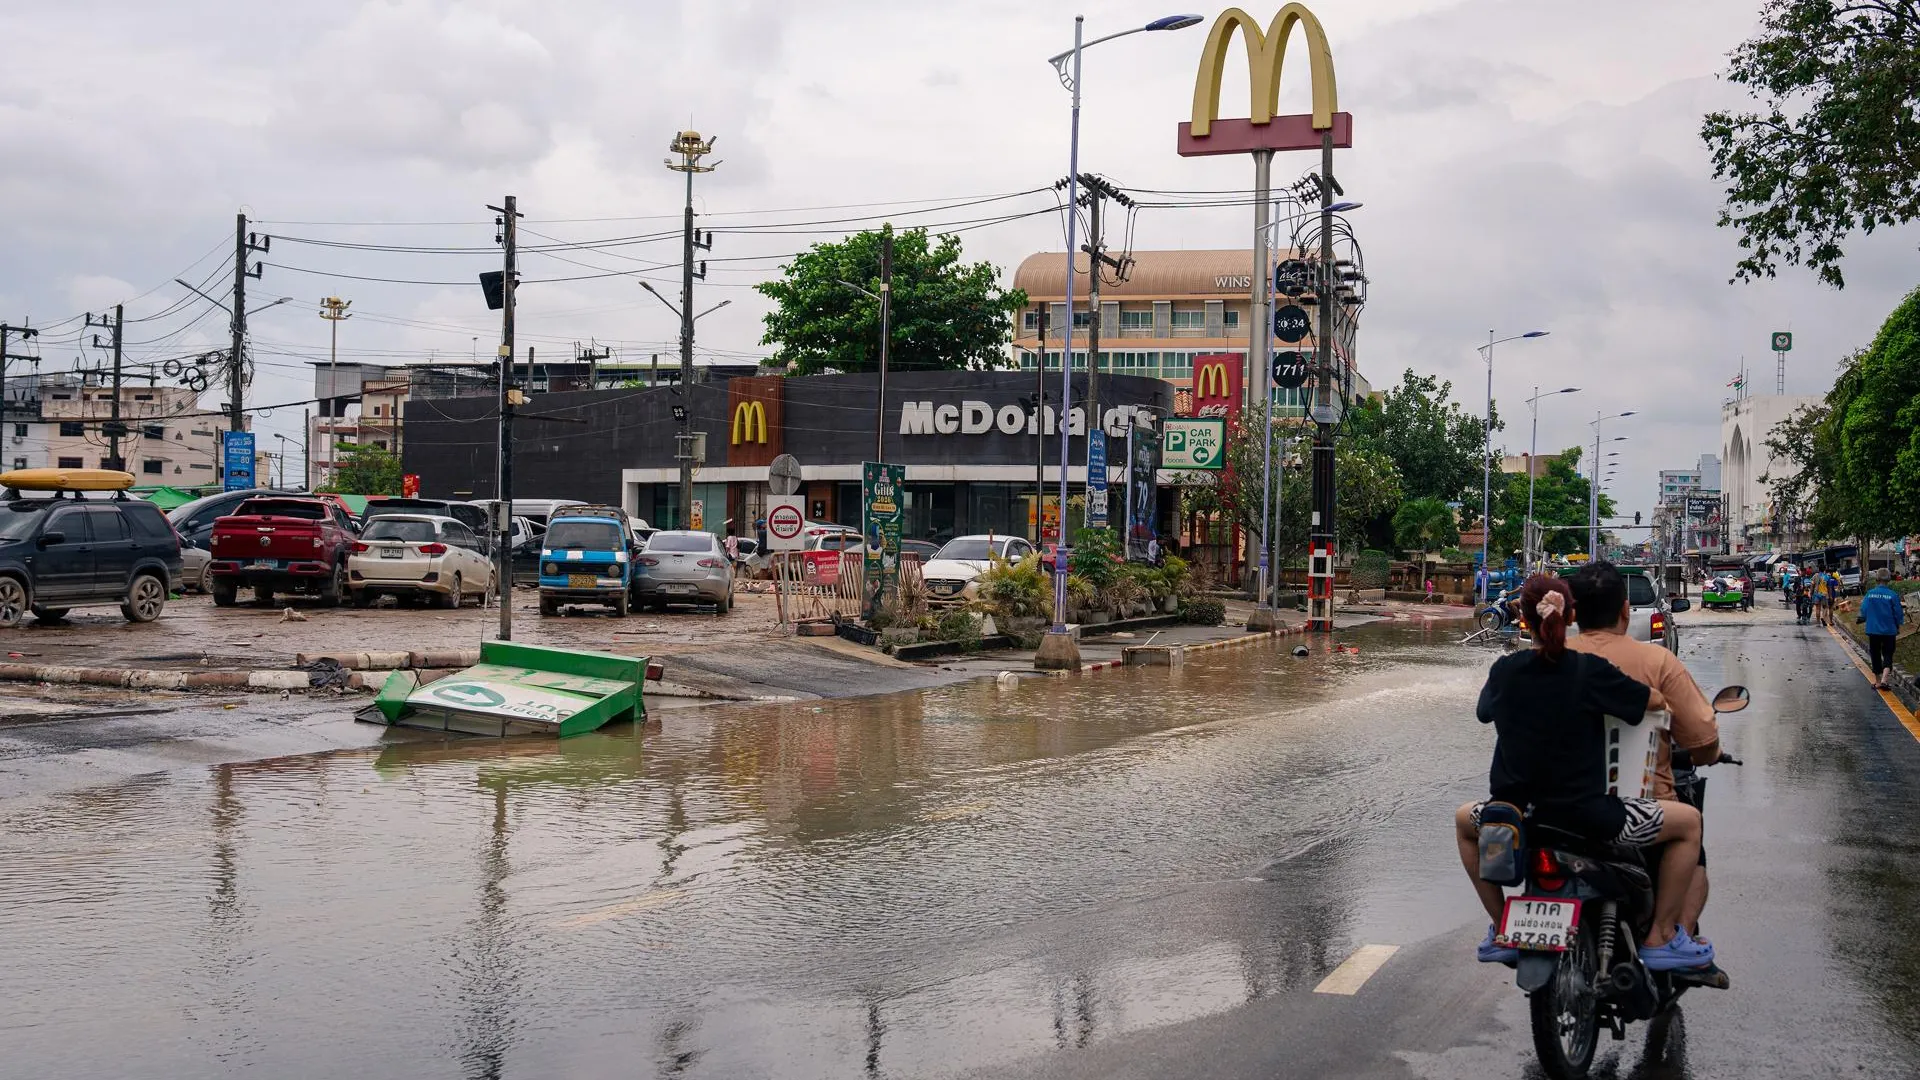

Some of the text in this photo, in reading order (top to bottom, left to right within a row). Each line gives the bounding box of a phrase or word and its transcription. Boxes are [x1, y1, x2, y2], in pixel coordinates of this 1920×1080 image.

[1275, 364, 1305, 376] 1711
[900, 401, 1156, 437] McDonad's
[1190, 428, 1211, 437] CAR
[1189, 439, 1216, 447] PARK
[1514, 917, 1563, 929] แม่ฮ่องสอน
[1511, 932, 1560, 946] 8786
